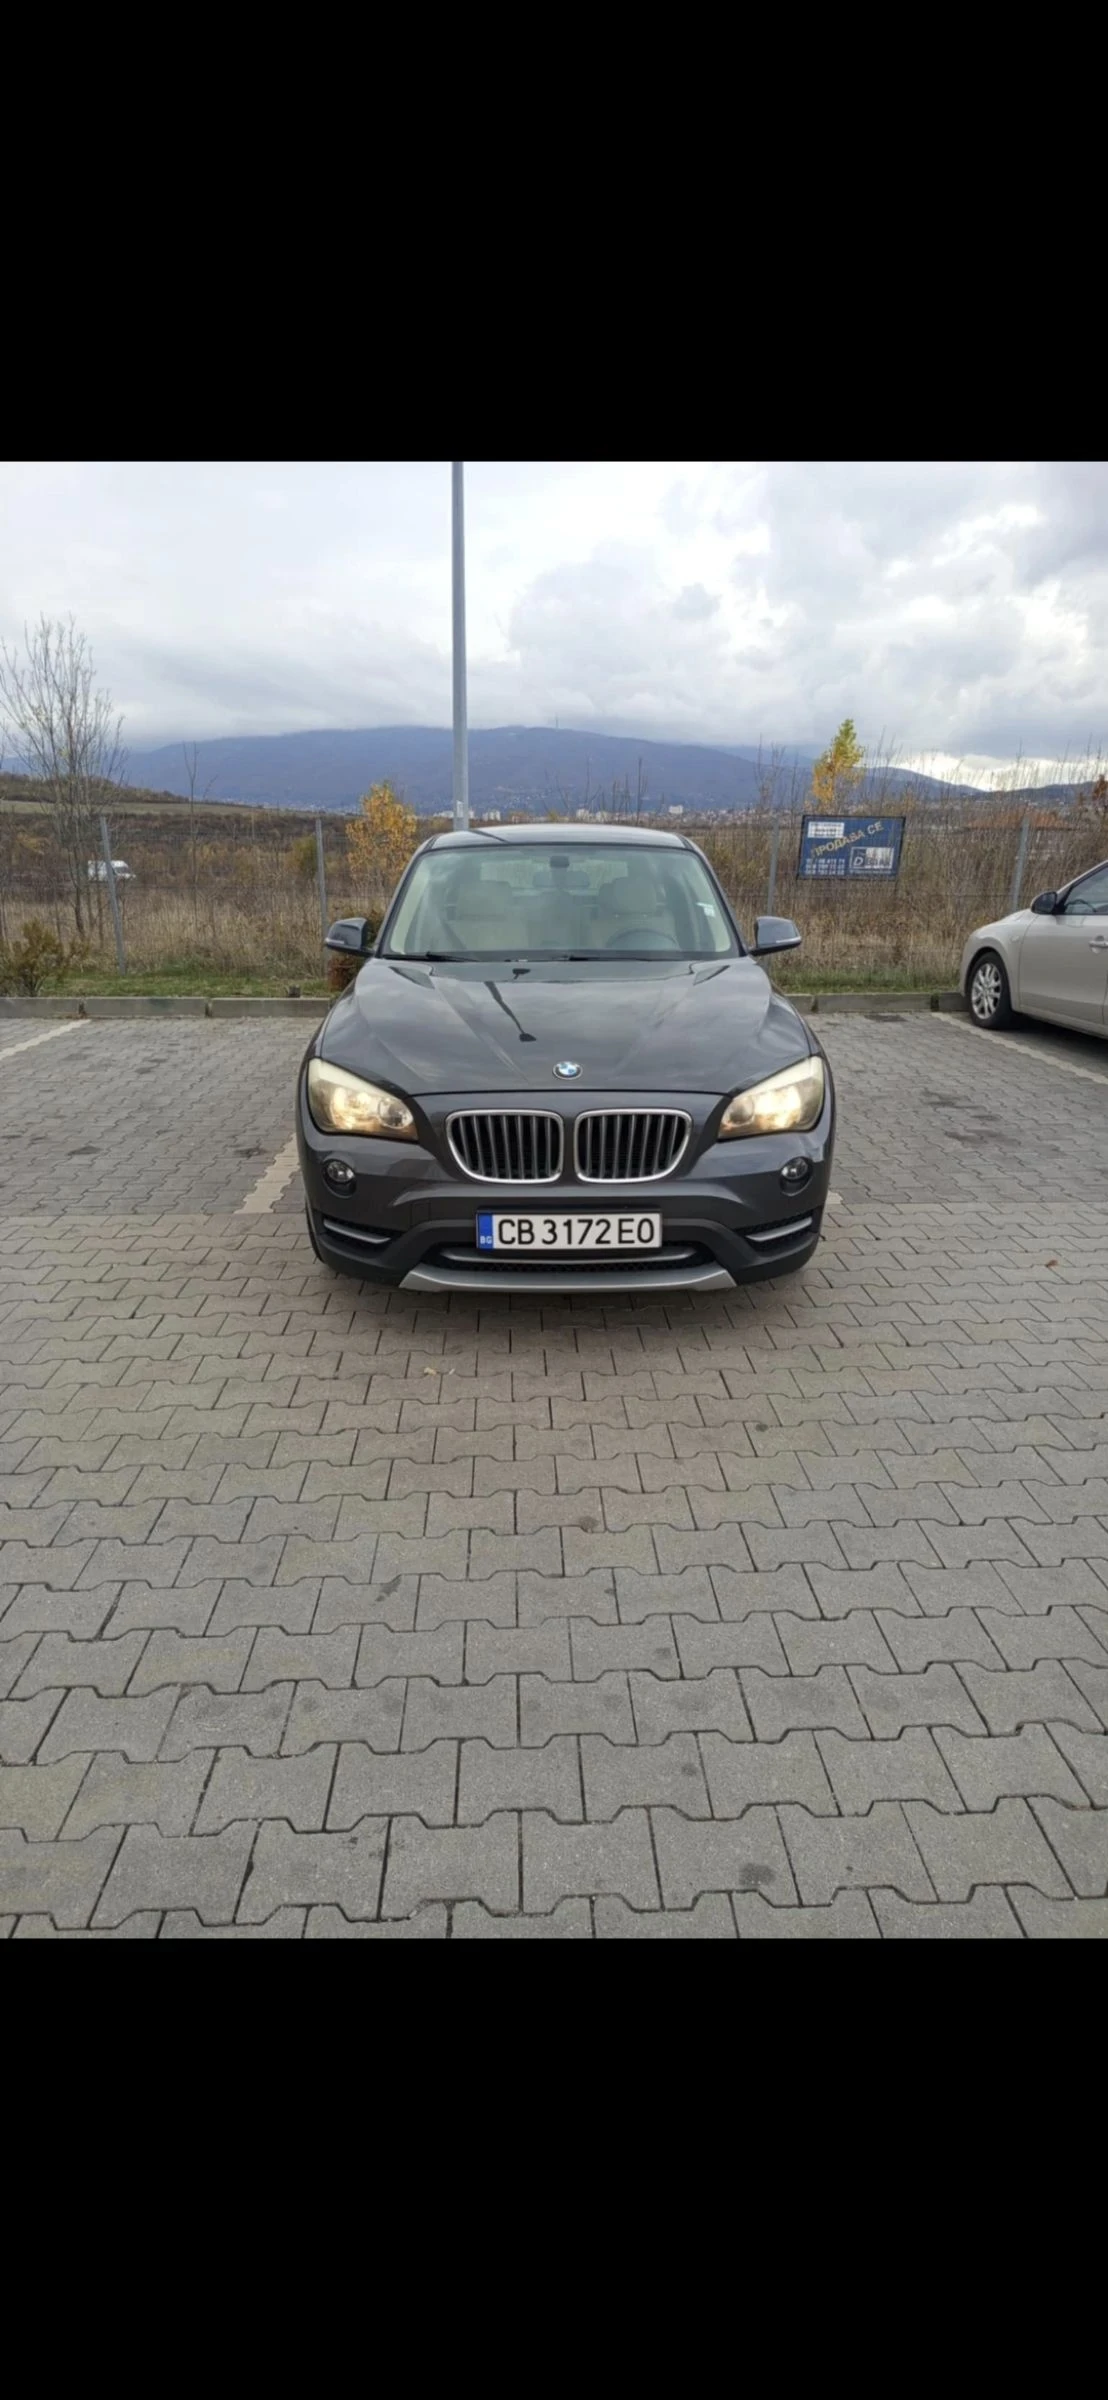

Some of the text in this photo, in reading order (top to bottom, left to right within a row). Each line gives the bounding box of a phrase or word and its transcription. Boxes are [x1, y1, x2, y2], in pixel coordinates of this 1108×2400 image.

[868, 821, 884, 835] СЕ
[498, 1218, 535, 1245] CB
[541, 1218, 612, 1245] 3172
[479, 1235, 492, 1244] BG
